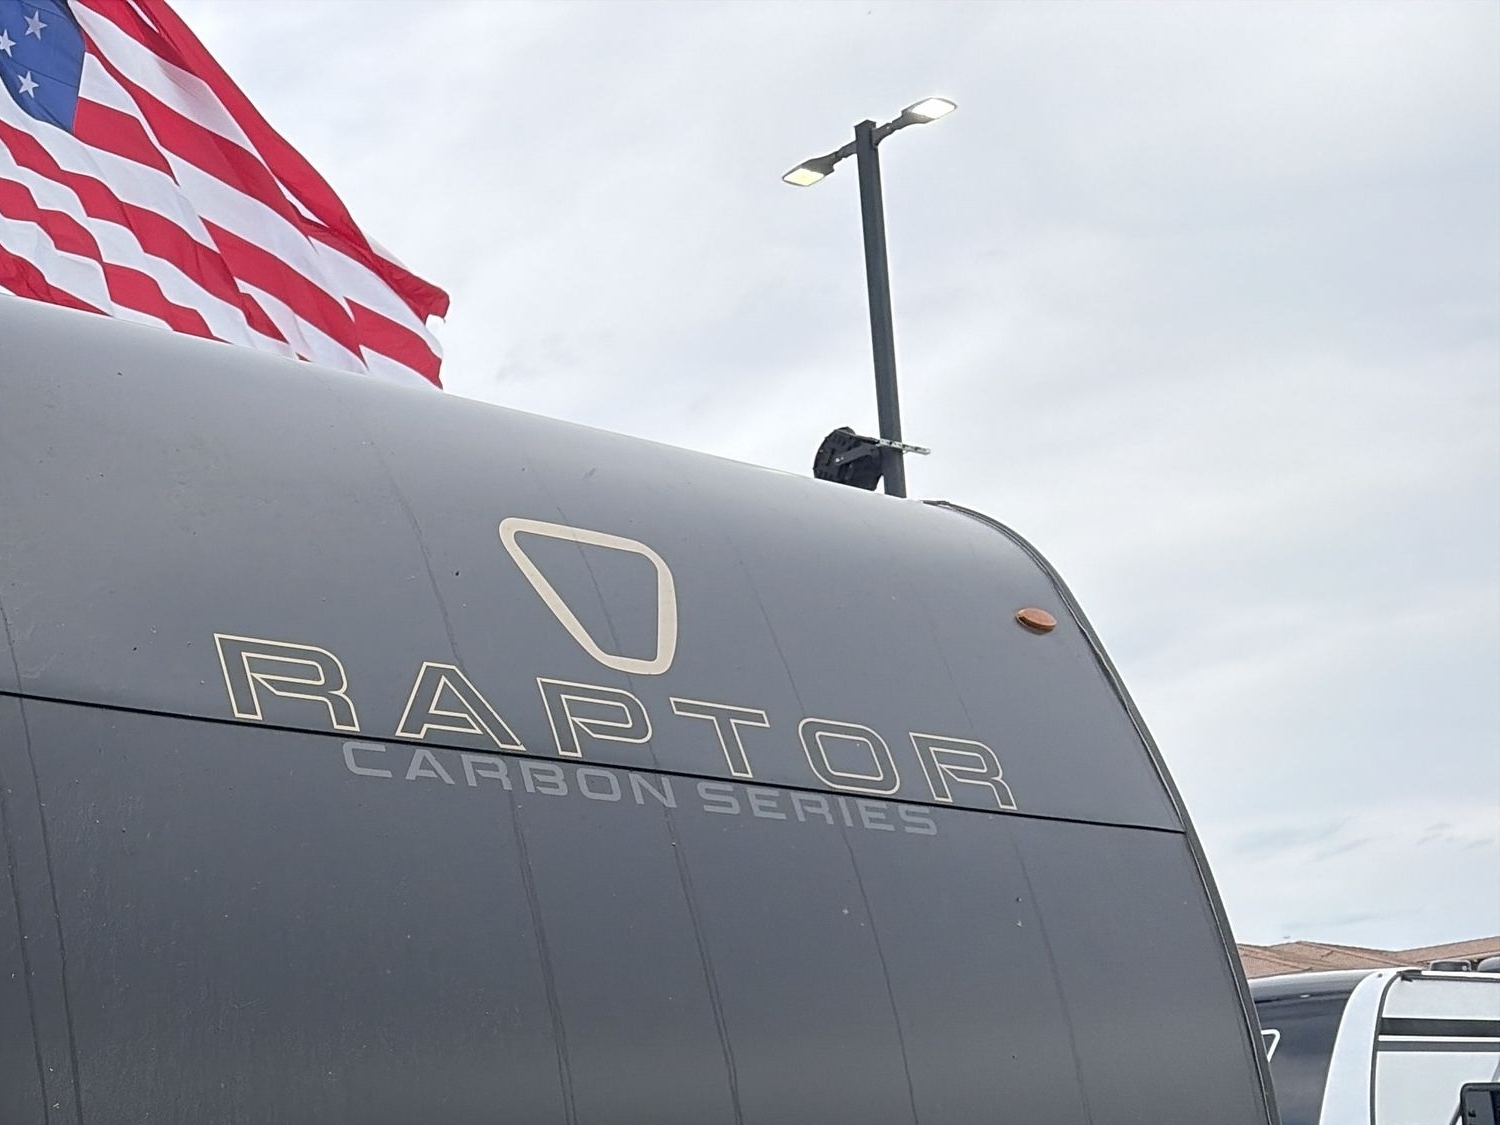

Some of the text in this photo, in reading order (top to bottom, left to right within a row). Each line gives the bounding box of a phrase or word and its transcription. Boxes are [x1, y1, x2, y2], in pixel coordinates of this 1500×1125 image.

[214, 633, 1018, 811] RAPTOR
[343, 740, 938, 836] CARBON SERIES
